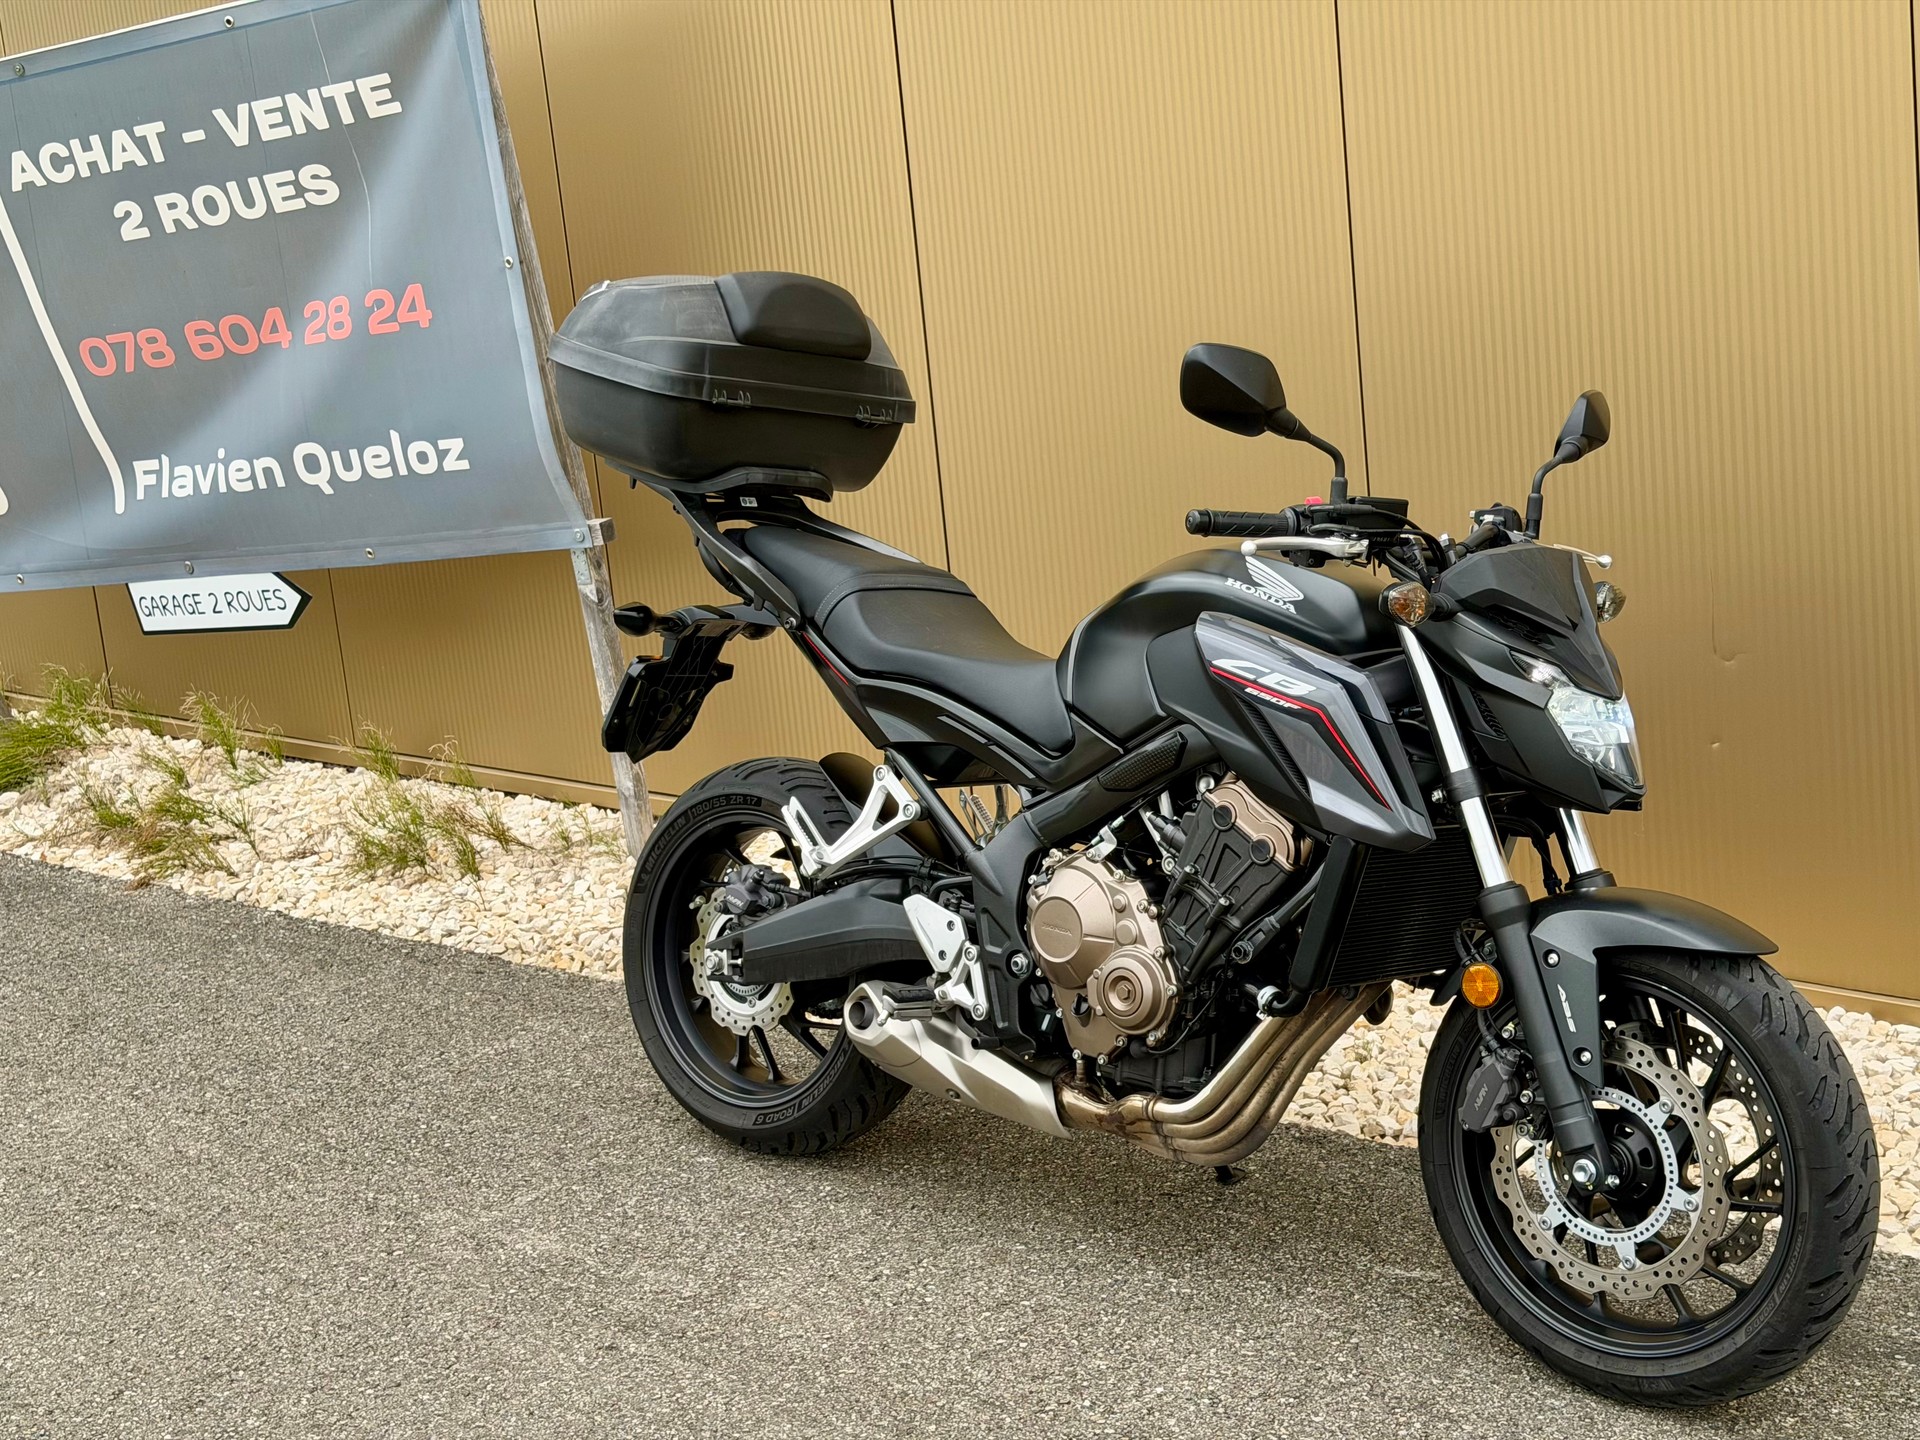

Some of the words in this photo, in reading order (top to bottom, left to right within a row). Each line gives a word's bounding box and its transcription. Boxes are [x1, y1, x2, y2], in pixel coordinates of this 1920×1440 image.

[11, 121, 166, 192] ACHAT
[211, 72, 403, 147] VENTE
[113, 200, 151, 242] 2
[153, 163, 340, 234] ROUES
[79, 329, 176, 376] 078
[184, 308, 292, 360] 604
[303, 296, 353, 345] 28
[364, 283, 432, 335] 24
[132, 448, 286, 501] Flavien
[292, 429, 470, 495] Queloz
[138, 593, 206, 618] GARAGE
[208, 592, 223, 614] 2
[224, 588, 287, 613] ROUES
[1224, 577, 1297, 615] HONDA
[1212, 658, 1317, 697] CB
[1244, 687, 1302, 710] 650F
[645, 817, 689, 872] MICHELIN
[692, 796, 727, 817] 180/55
[729, 795, 744, 805] ZR
[745, 796, 758, 805] 17
[1557, 983, 1577, 1033] ABS
[801, 1050, 846, 1109] MICHELIN
[755, 1114, 764, 1124] 6
[765, 1105, 795, 1123] ROAD
